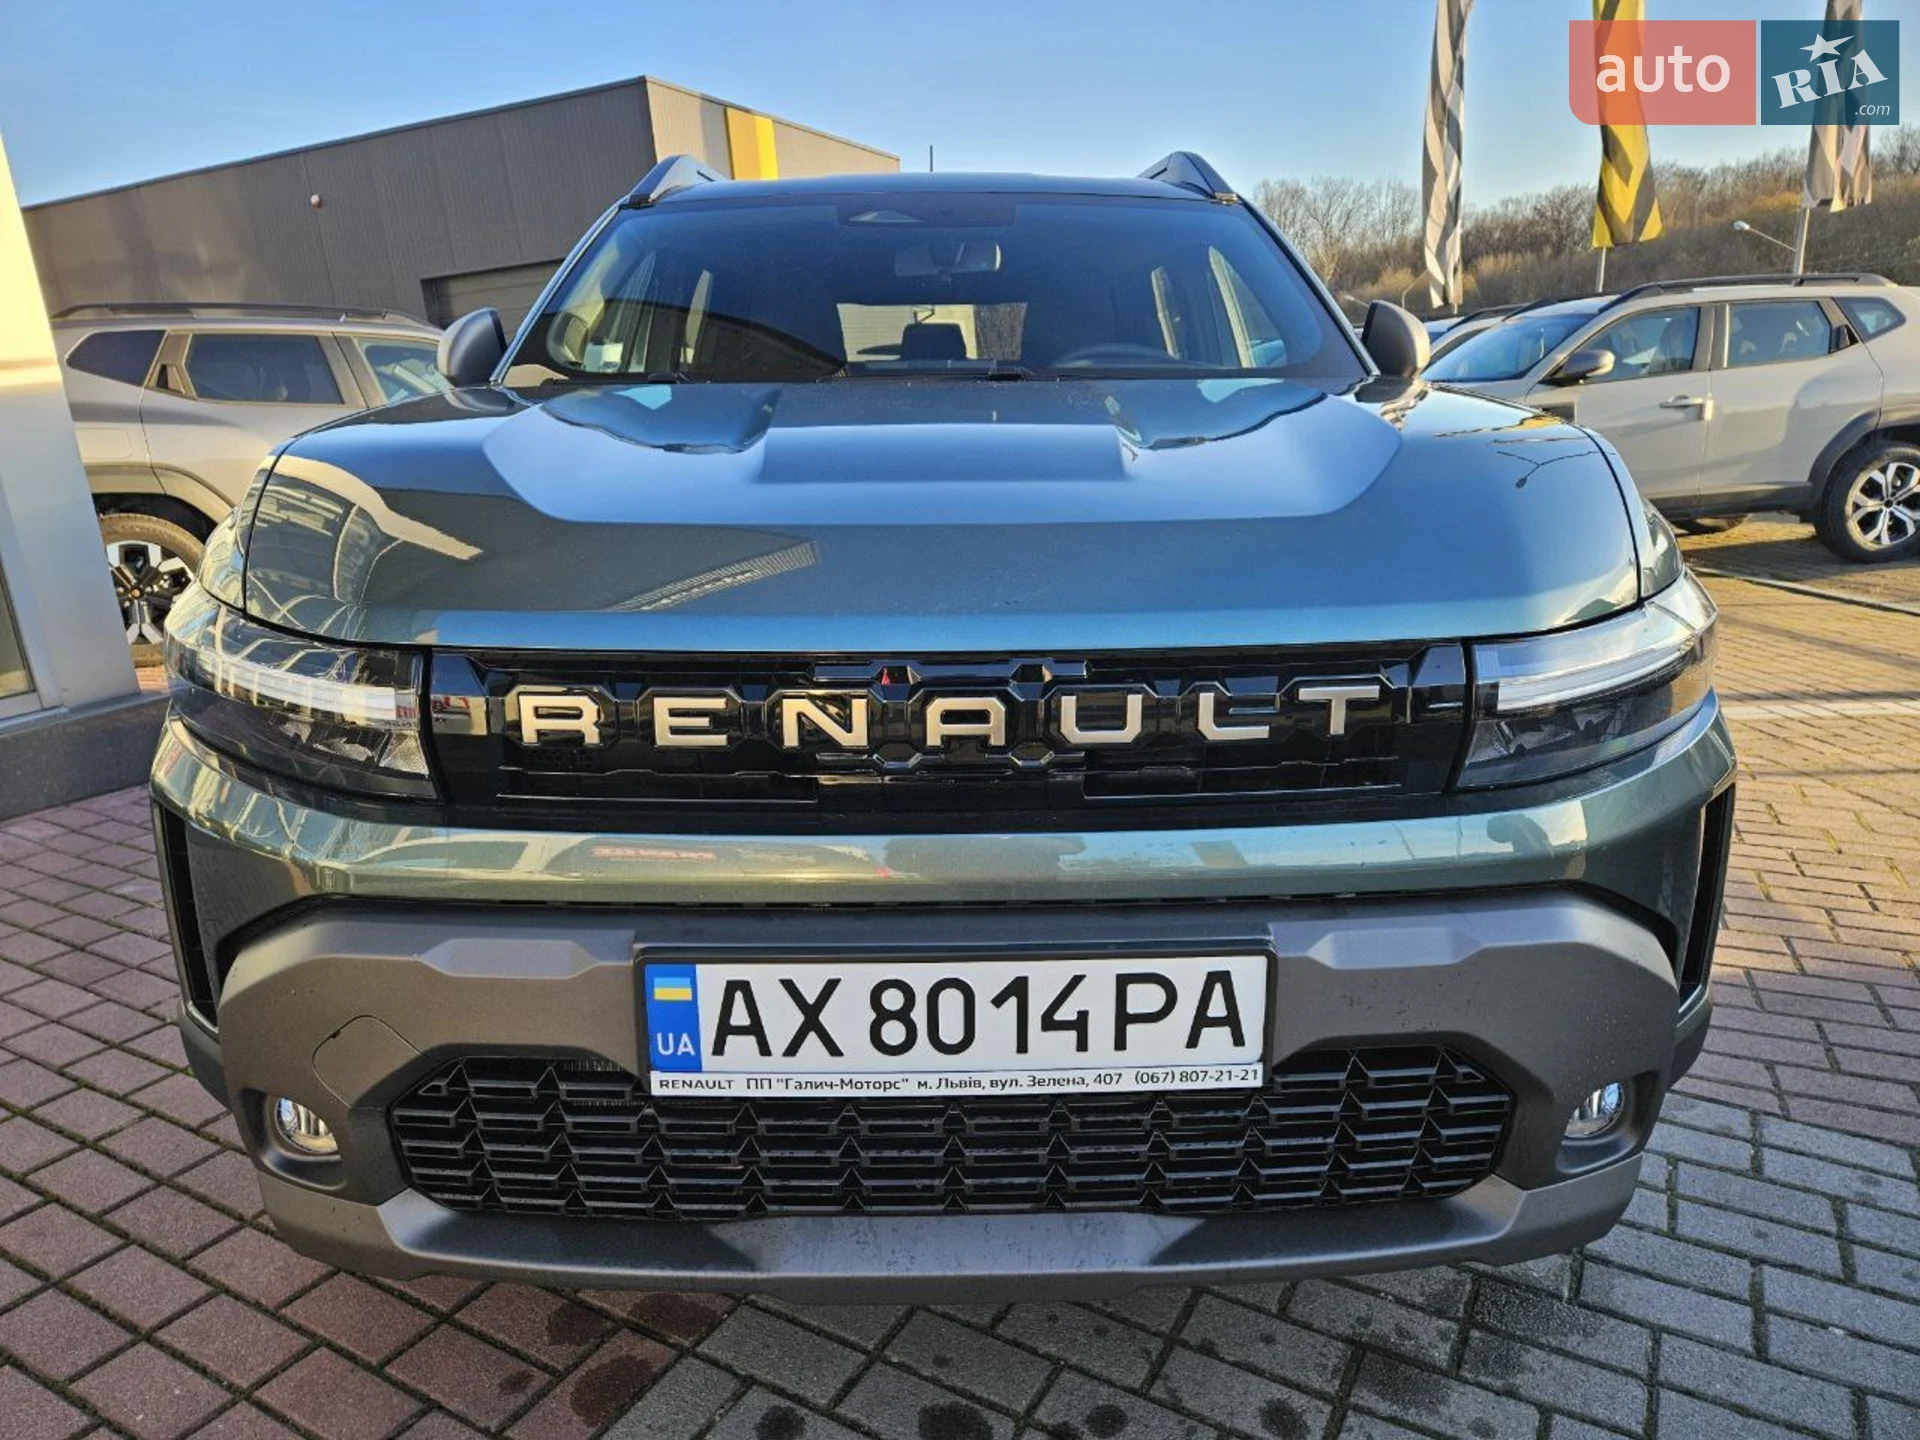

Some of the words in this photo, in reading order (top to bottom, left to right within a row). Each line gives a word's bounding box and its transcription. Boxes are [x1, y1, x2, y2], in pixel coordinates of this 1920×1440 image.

[520, 684, 1381, 748] RENAULT
[711, 977, 844, 1057] AX
[870, 974, 1089, 1056] 8014
[1114, 970, 1246, 1051] PA
[657, 1032, 695, 1056] UA
[659, 1079, 734, 1090] RENAULT
[747, 1078, 772, 1090] ПП
[776, 1078, 908, 1092] "Галич-Моторс"
[917, 1081, 932, 1090] м.
[936, 1077, 986, 1091] Львів,
[990, 1077, 1023, 1089] вул.
[1027, 1075, 1090, 1089] Зелена,
[1093, 1073, 1122, 1085] 407
[1134, 1070, 1175, 1085] (067)
[1179, 1069, 1258, 1083] 807-21-21
